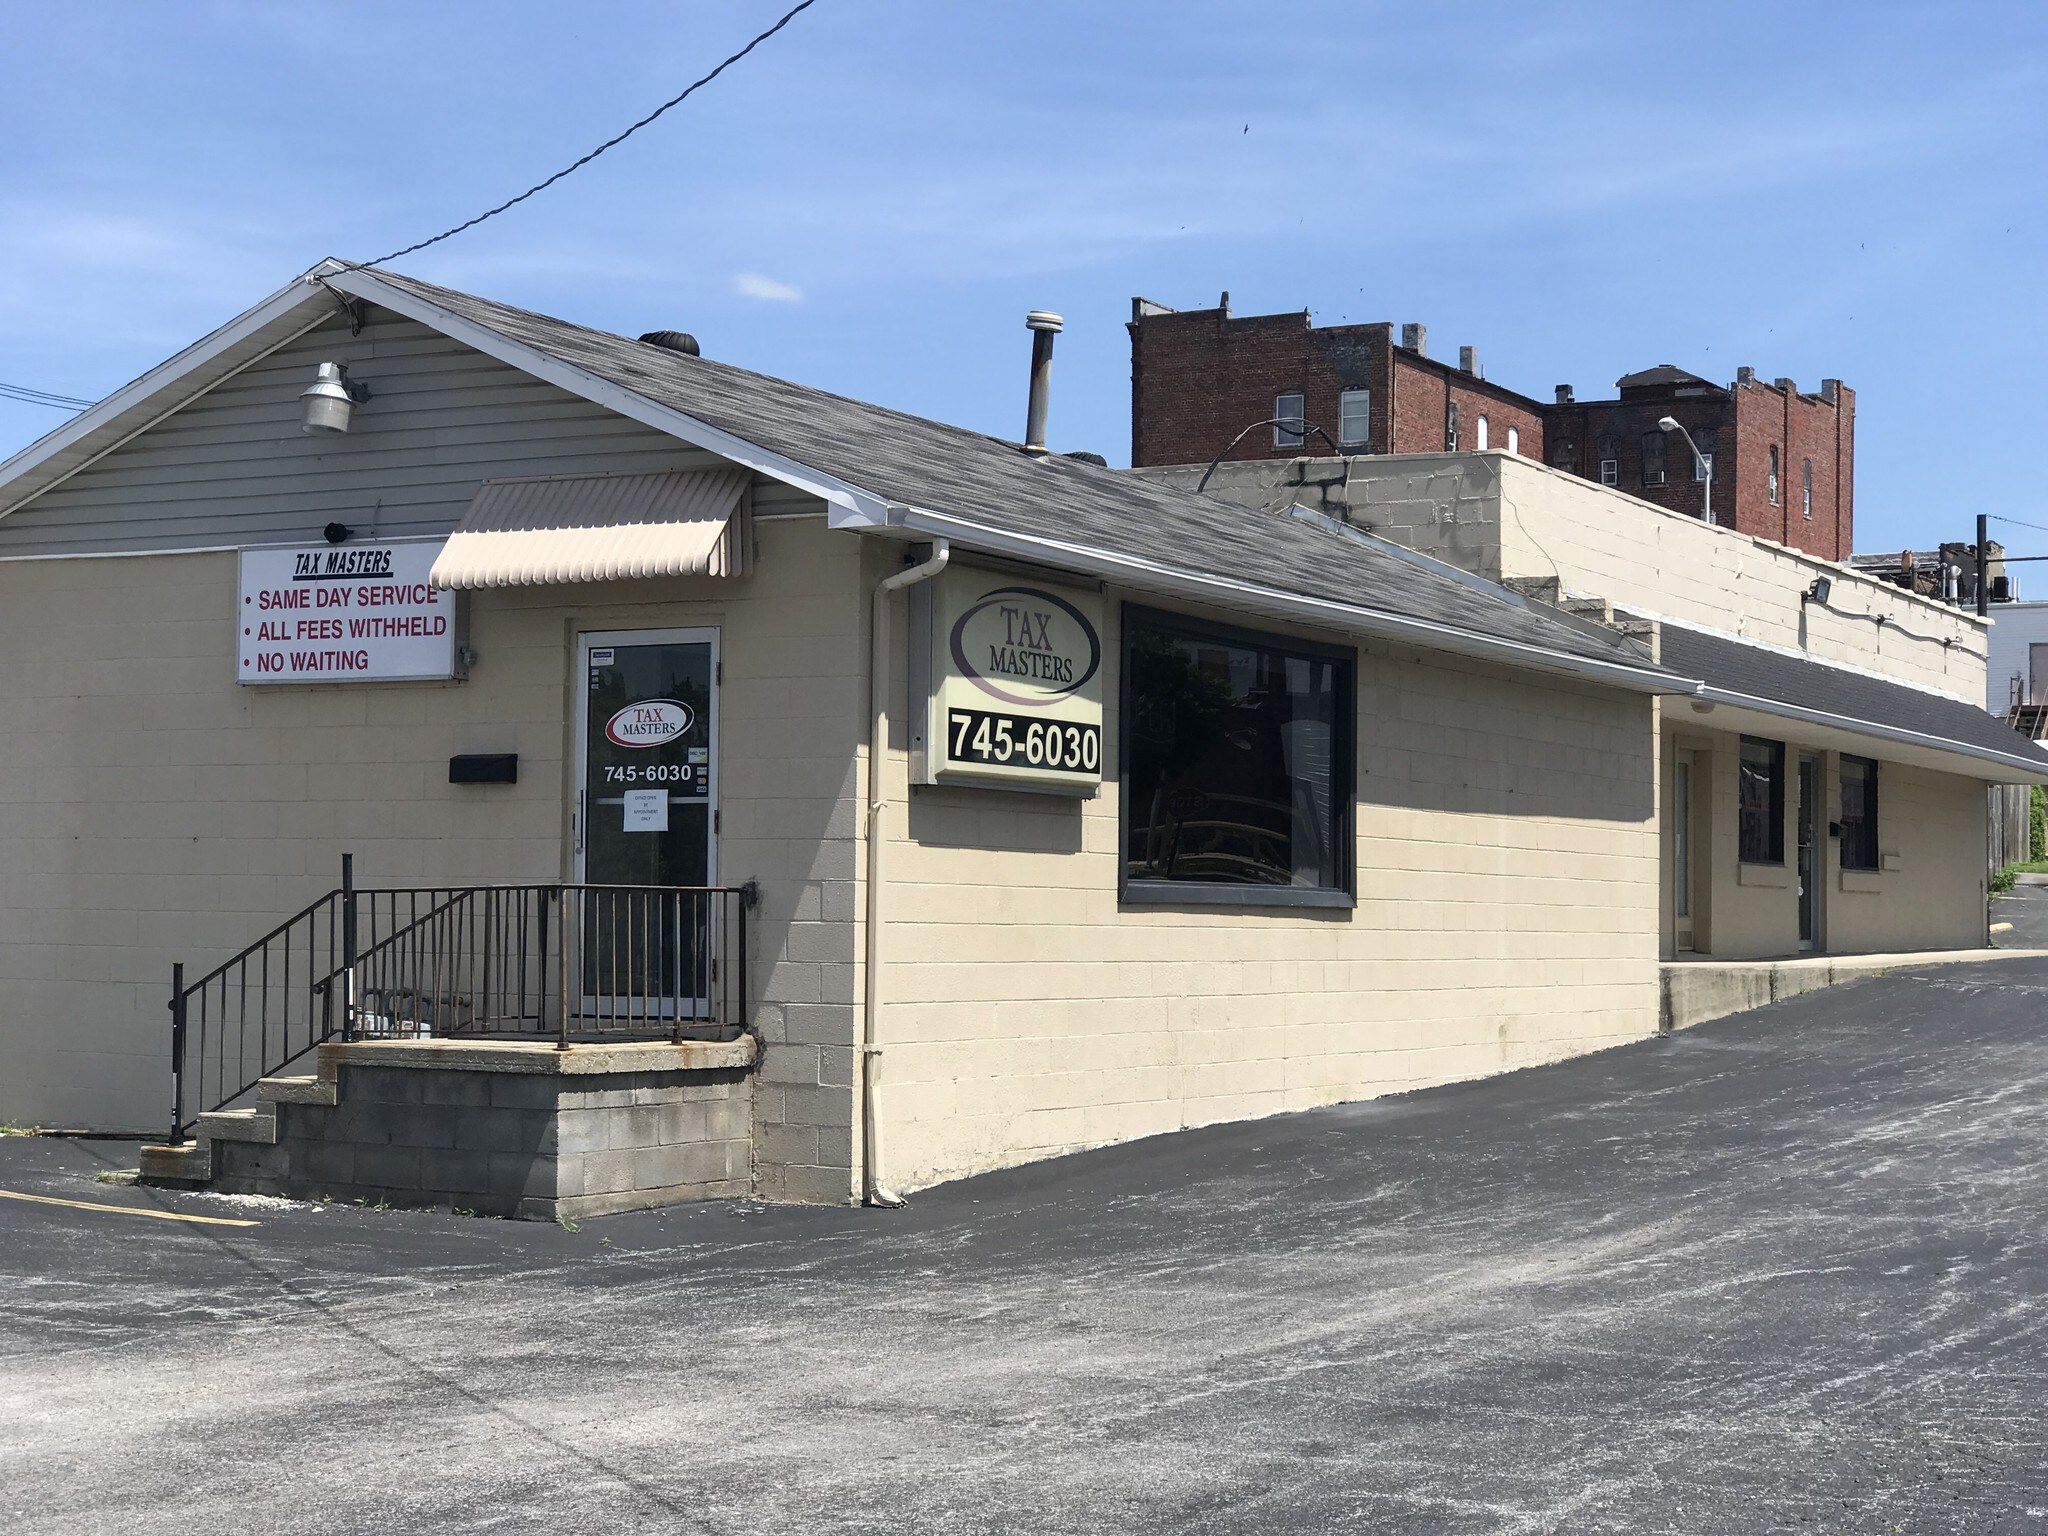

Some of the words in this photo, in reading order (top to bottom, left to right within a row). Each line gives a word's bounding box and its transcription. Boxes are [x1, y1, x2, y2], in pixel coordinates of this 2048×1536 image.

[295, 553, 321, 574] TAX
[325, 550, 391, 573] MASTERS
[258, 589, 310, 610] SAME
[316, 587, 352, 607] DAY
[357, 584, 438, 606] SERVICE
[257, 621, 291, 641] ALL
[297, 619, 343, 639] FEES
[349, 615, 446, 638] WITHHELD
[1000, 606, 1052, 650] TAX
[257, 652, 284, 672] NO
[290, 650, 368, 671] WAITING
[989, 645, 1072, 683] MASTERS
[634, 708, 663, 722] TAX
[623, 722, 675, 735] MASTERS
[951, 713, 1098, 770] 745-6030
[604, 765, 691, 782] 745-6030
